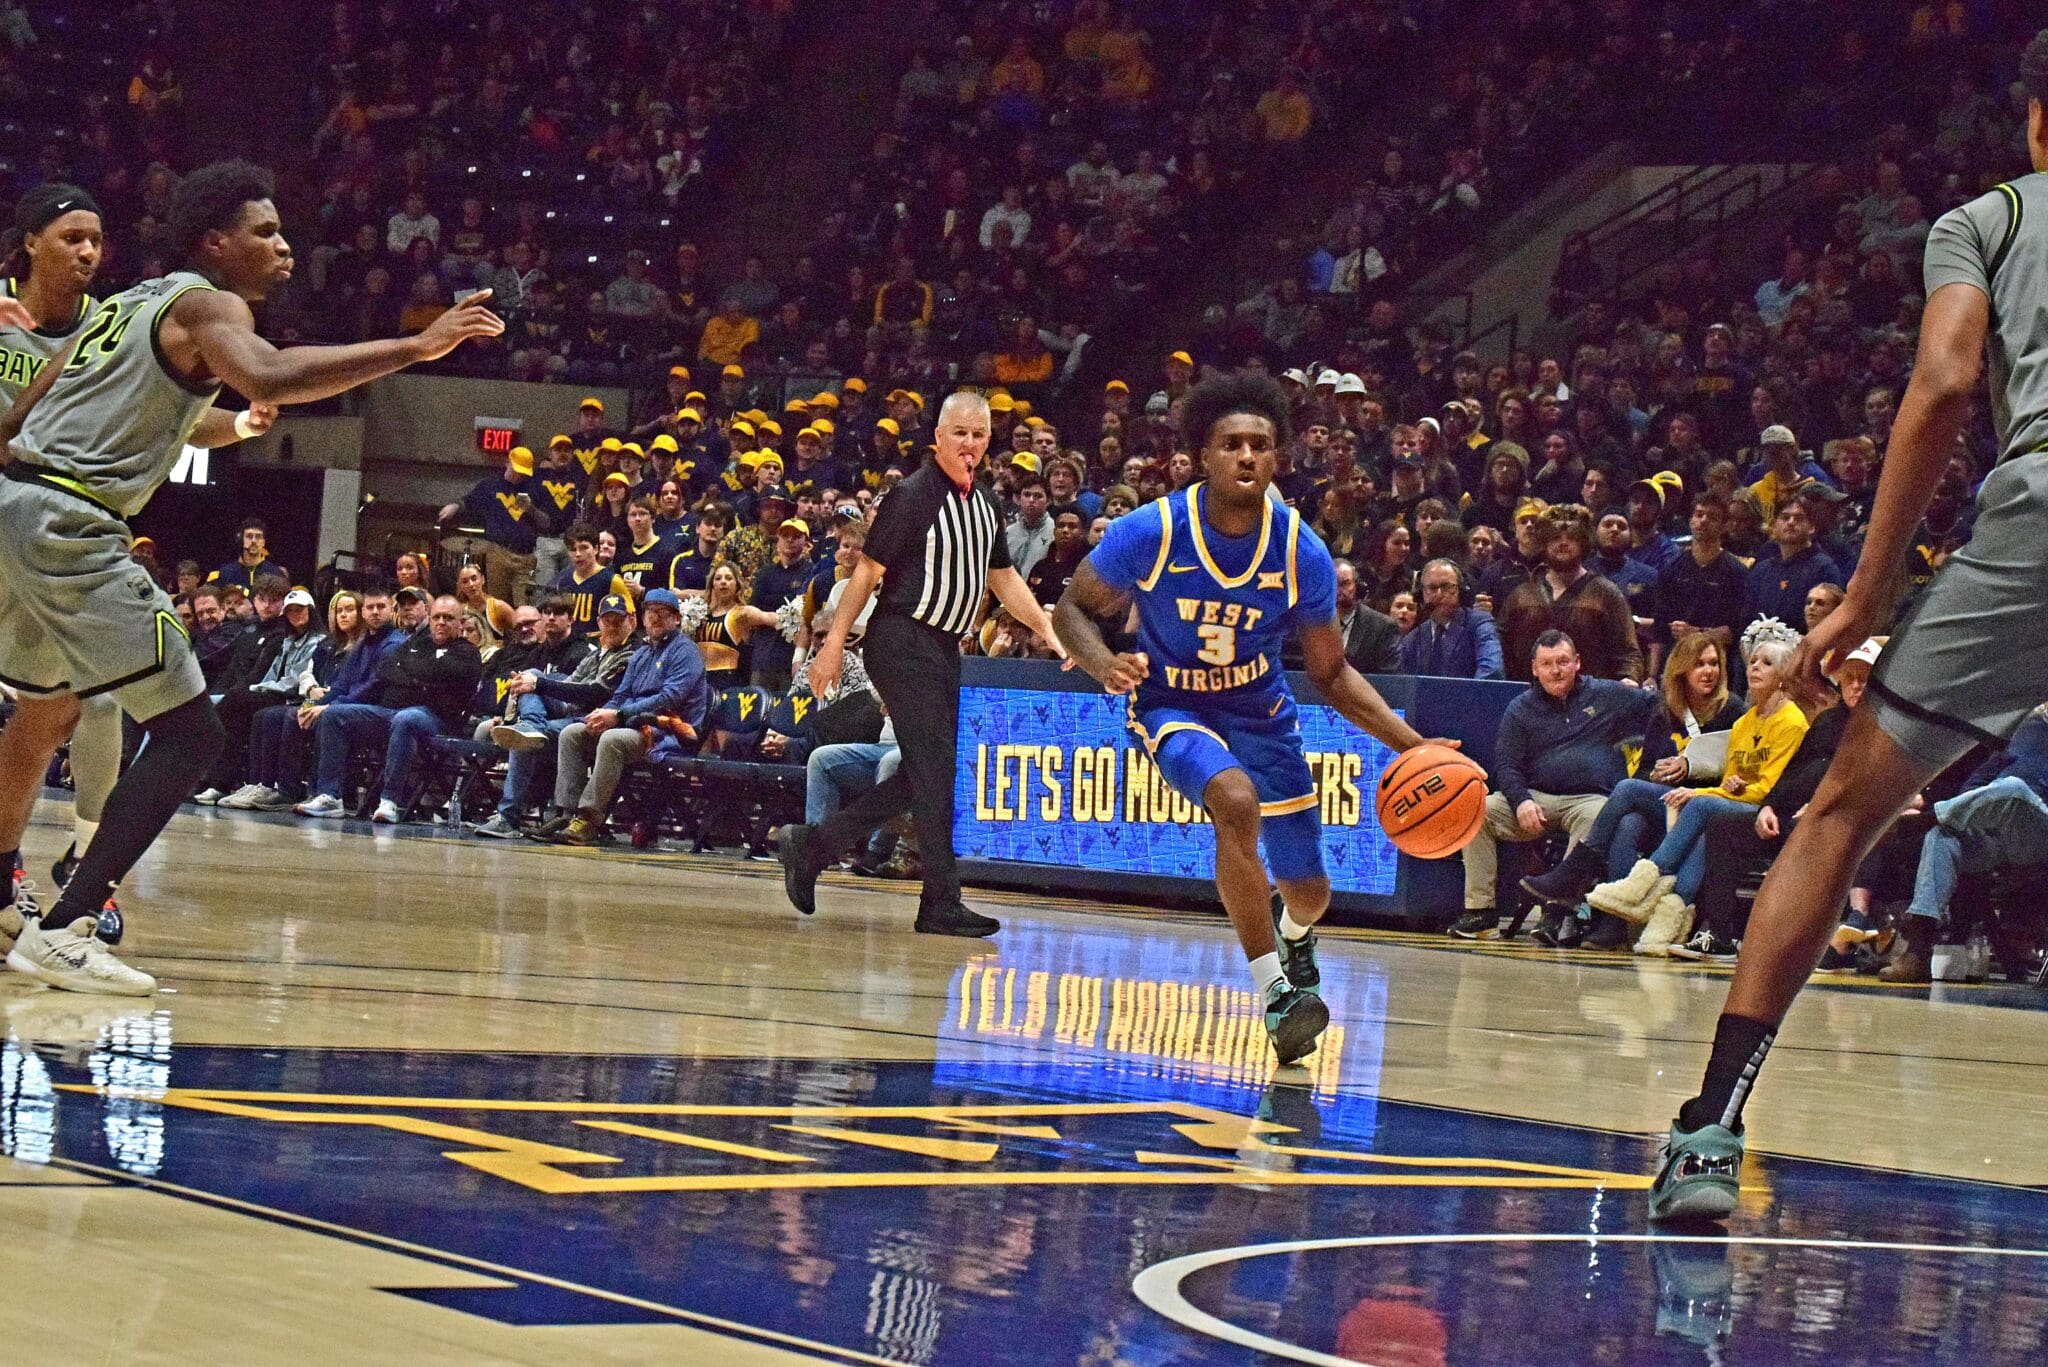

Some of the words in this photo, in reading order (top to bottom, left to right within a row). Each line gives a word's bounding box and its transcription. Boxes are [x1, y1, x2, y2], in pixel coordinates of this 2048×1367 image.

[64, 300, 147, 371] 24
[484, 429, 512, 450] EXIT
[1176, 598, 1263, 631] WEST
[1197, 623, 1236, 667] 3
[1165, 652, 1269, 692] VIRGINIA
[976, 743, 1063, 822] LET'S
[1073, 746, 1116, 823] GO
[1392, 773, 1446, 819] ELITE
